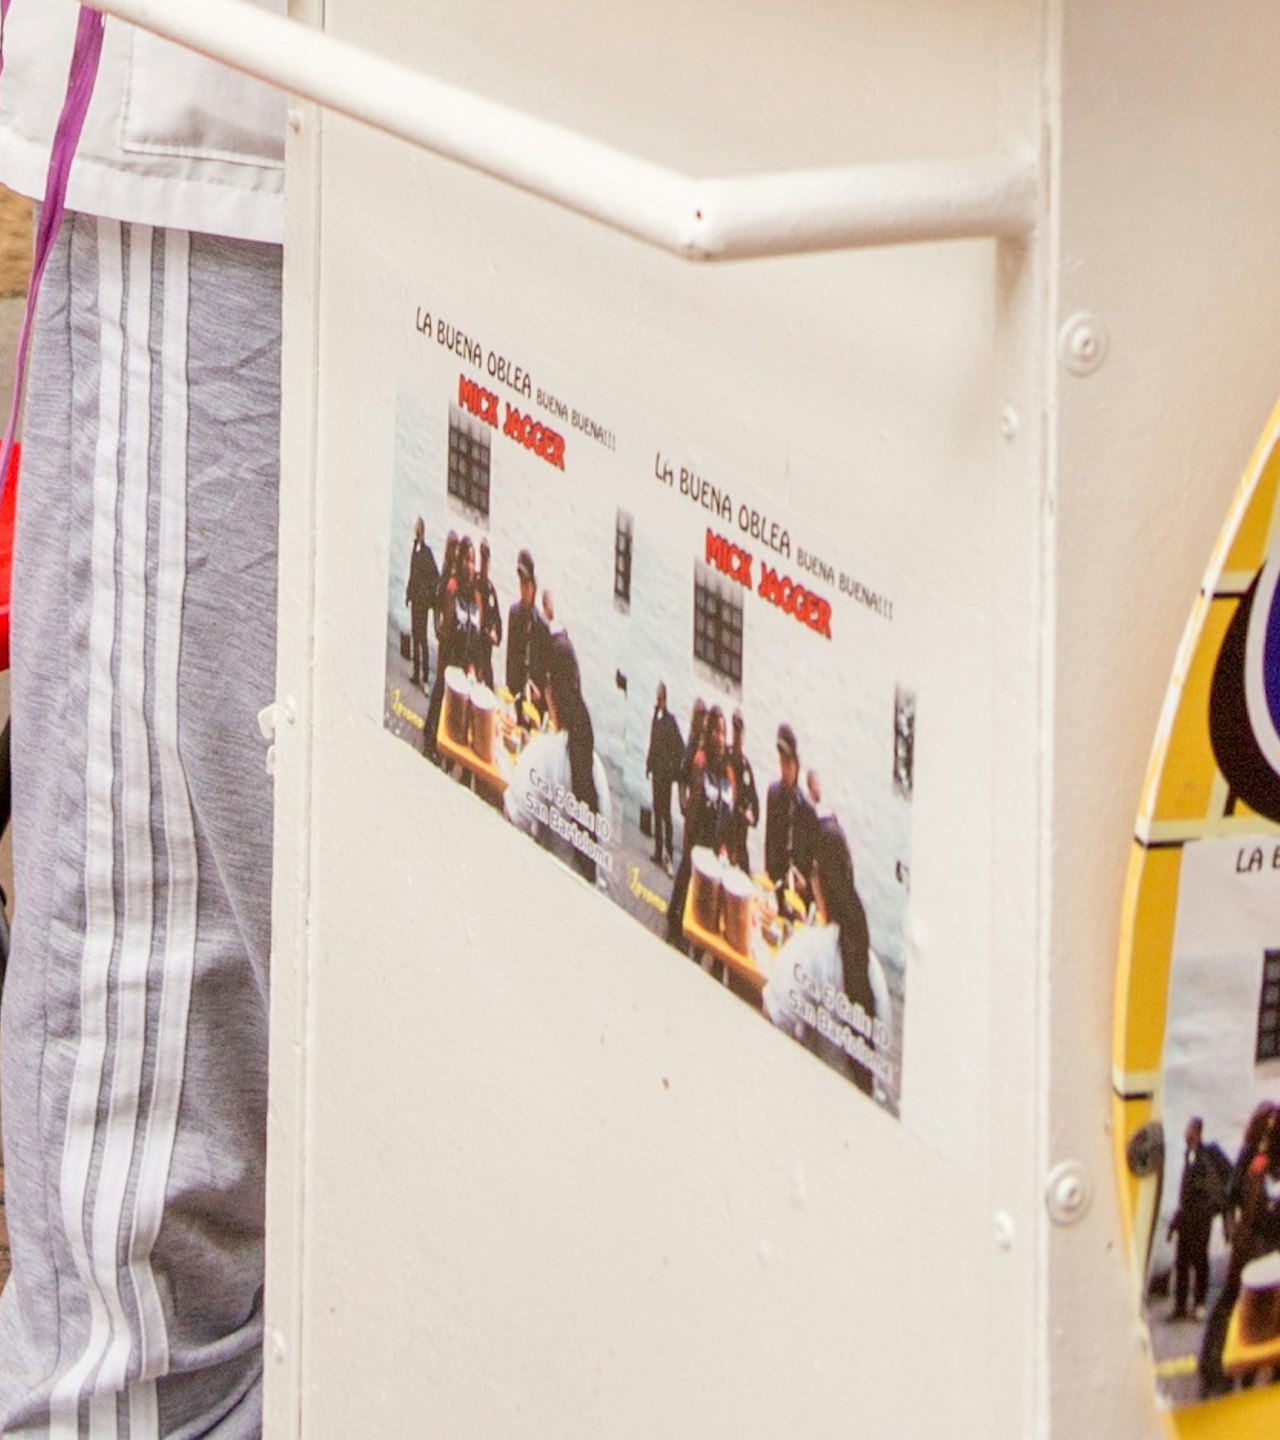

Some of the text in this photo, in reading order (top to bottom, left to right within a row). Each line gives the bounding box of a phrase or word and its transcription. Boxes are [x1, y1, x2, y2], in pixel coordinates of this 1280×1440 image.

[415, 306, 432, 337] LA
[437, 319, 482, 370] BUENA
[487, 351, 531, 399] OBLEA
[537, 388, 568, 422] BUENA
[458, 373, 565, 472] MICK JAGGER
[680, 467, 731, 523] BUENA
[738, 504, 791, 559] OBLEA
[797, 547, 835, 586] BUENA
[706, 527, 832, 641] MICK JAGGER
[1236, 846, 1263, 873] LA
